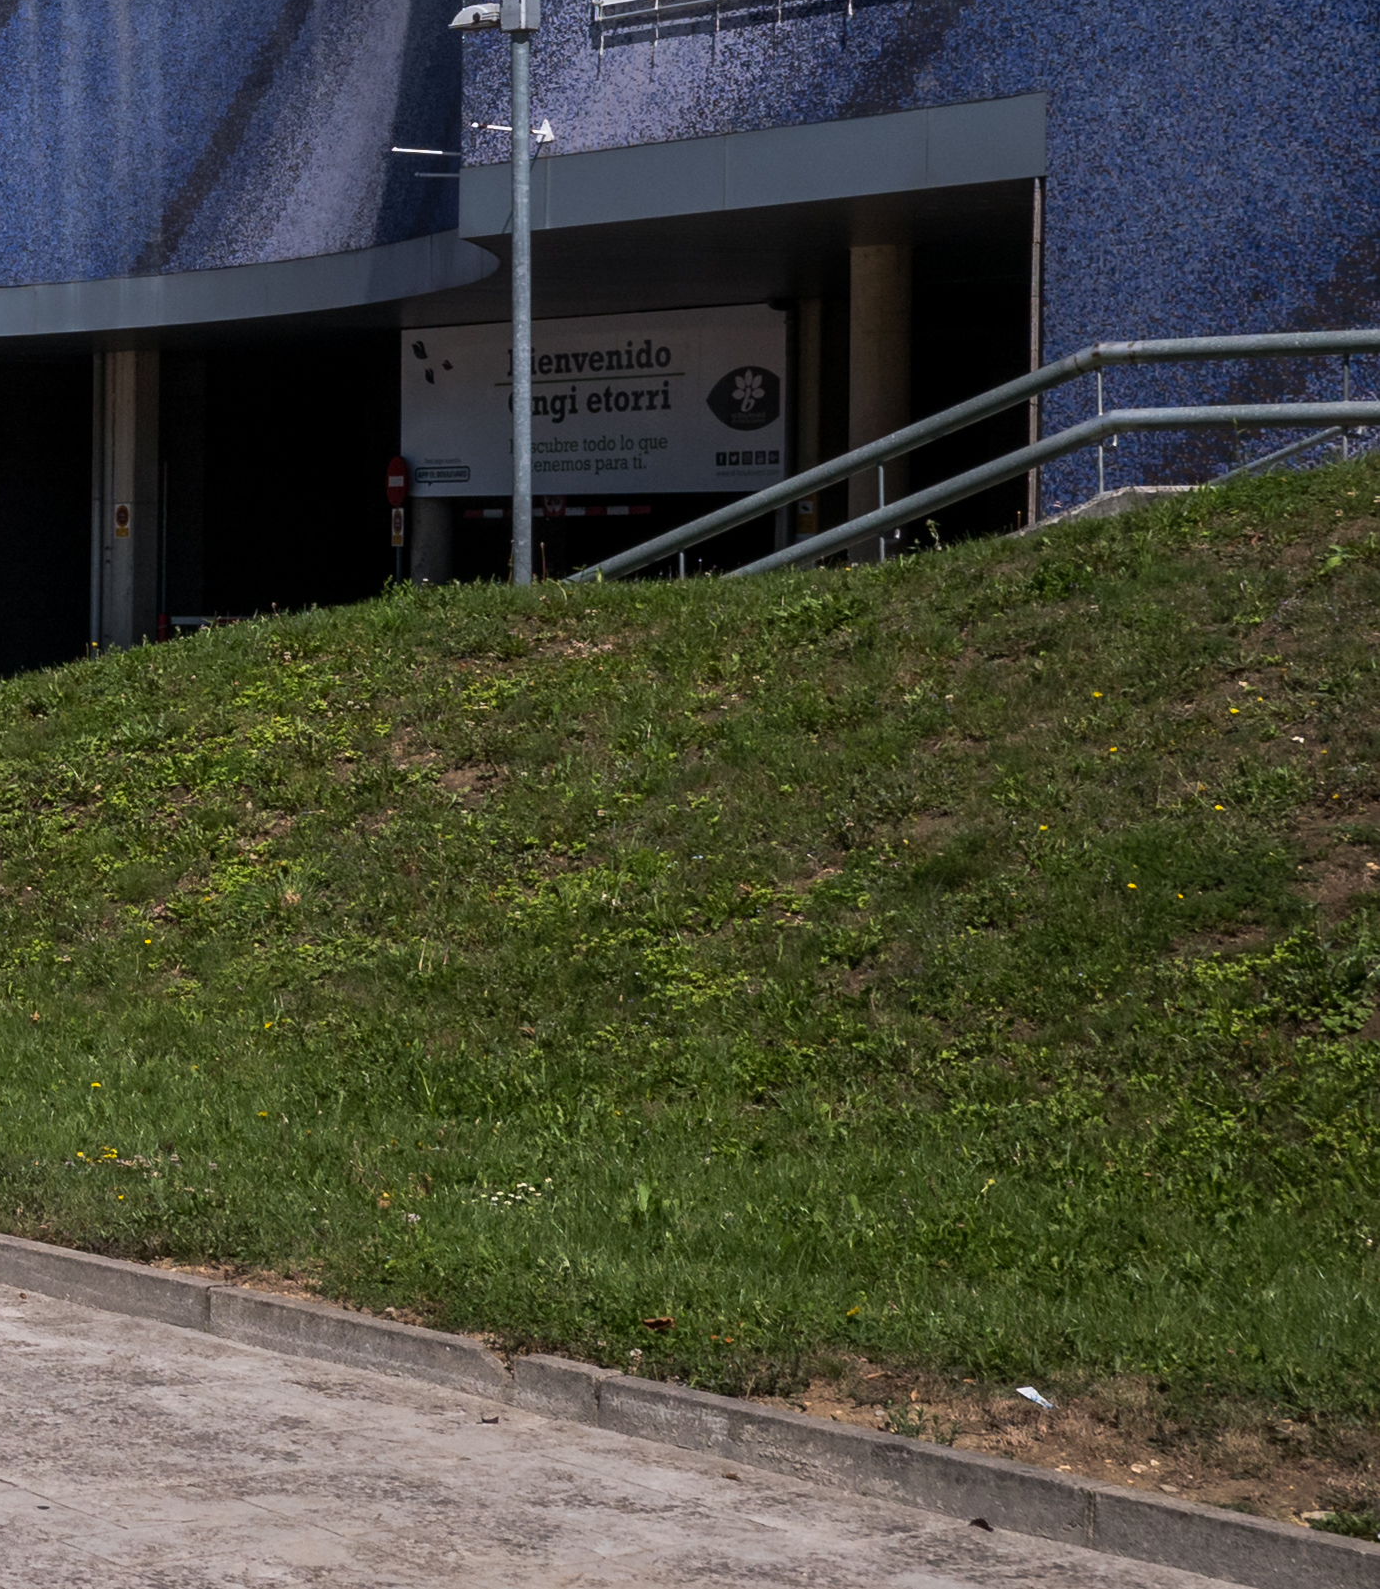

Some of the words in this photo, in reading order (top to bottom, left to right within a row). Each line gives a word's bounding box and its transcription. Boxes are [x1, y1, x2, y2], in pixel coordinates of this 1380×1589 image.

[587, 380, 671, 414] etorri
[509, 437, 578, 454] scubre
[583, 436, 616, 451] todo
[620, 434, 634, 450] lo
[638, 437, 668, 454] que
[595, 457, 628, 475] para
[633, 453, 647, 470] ti.
